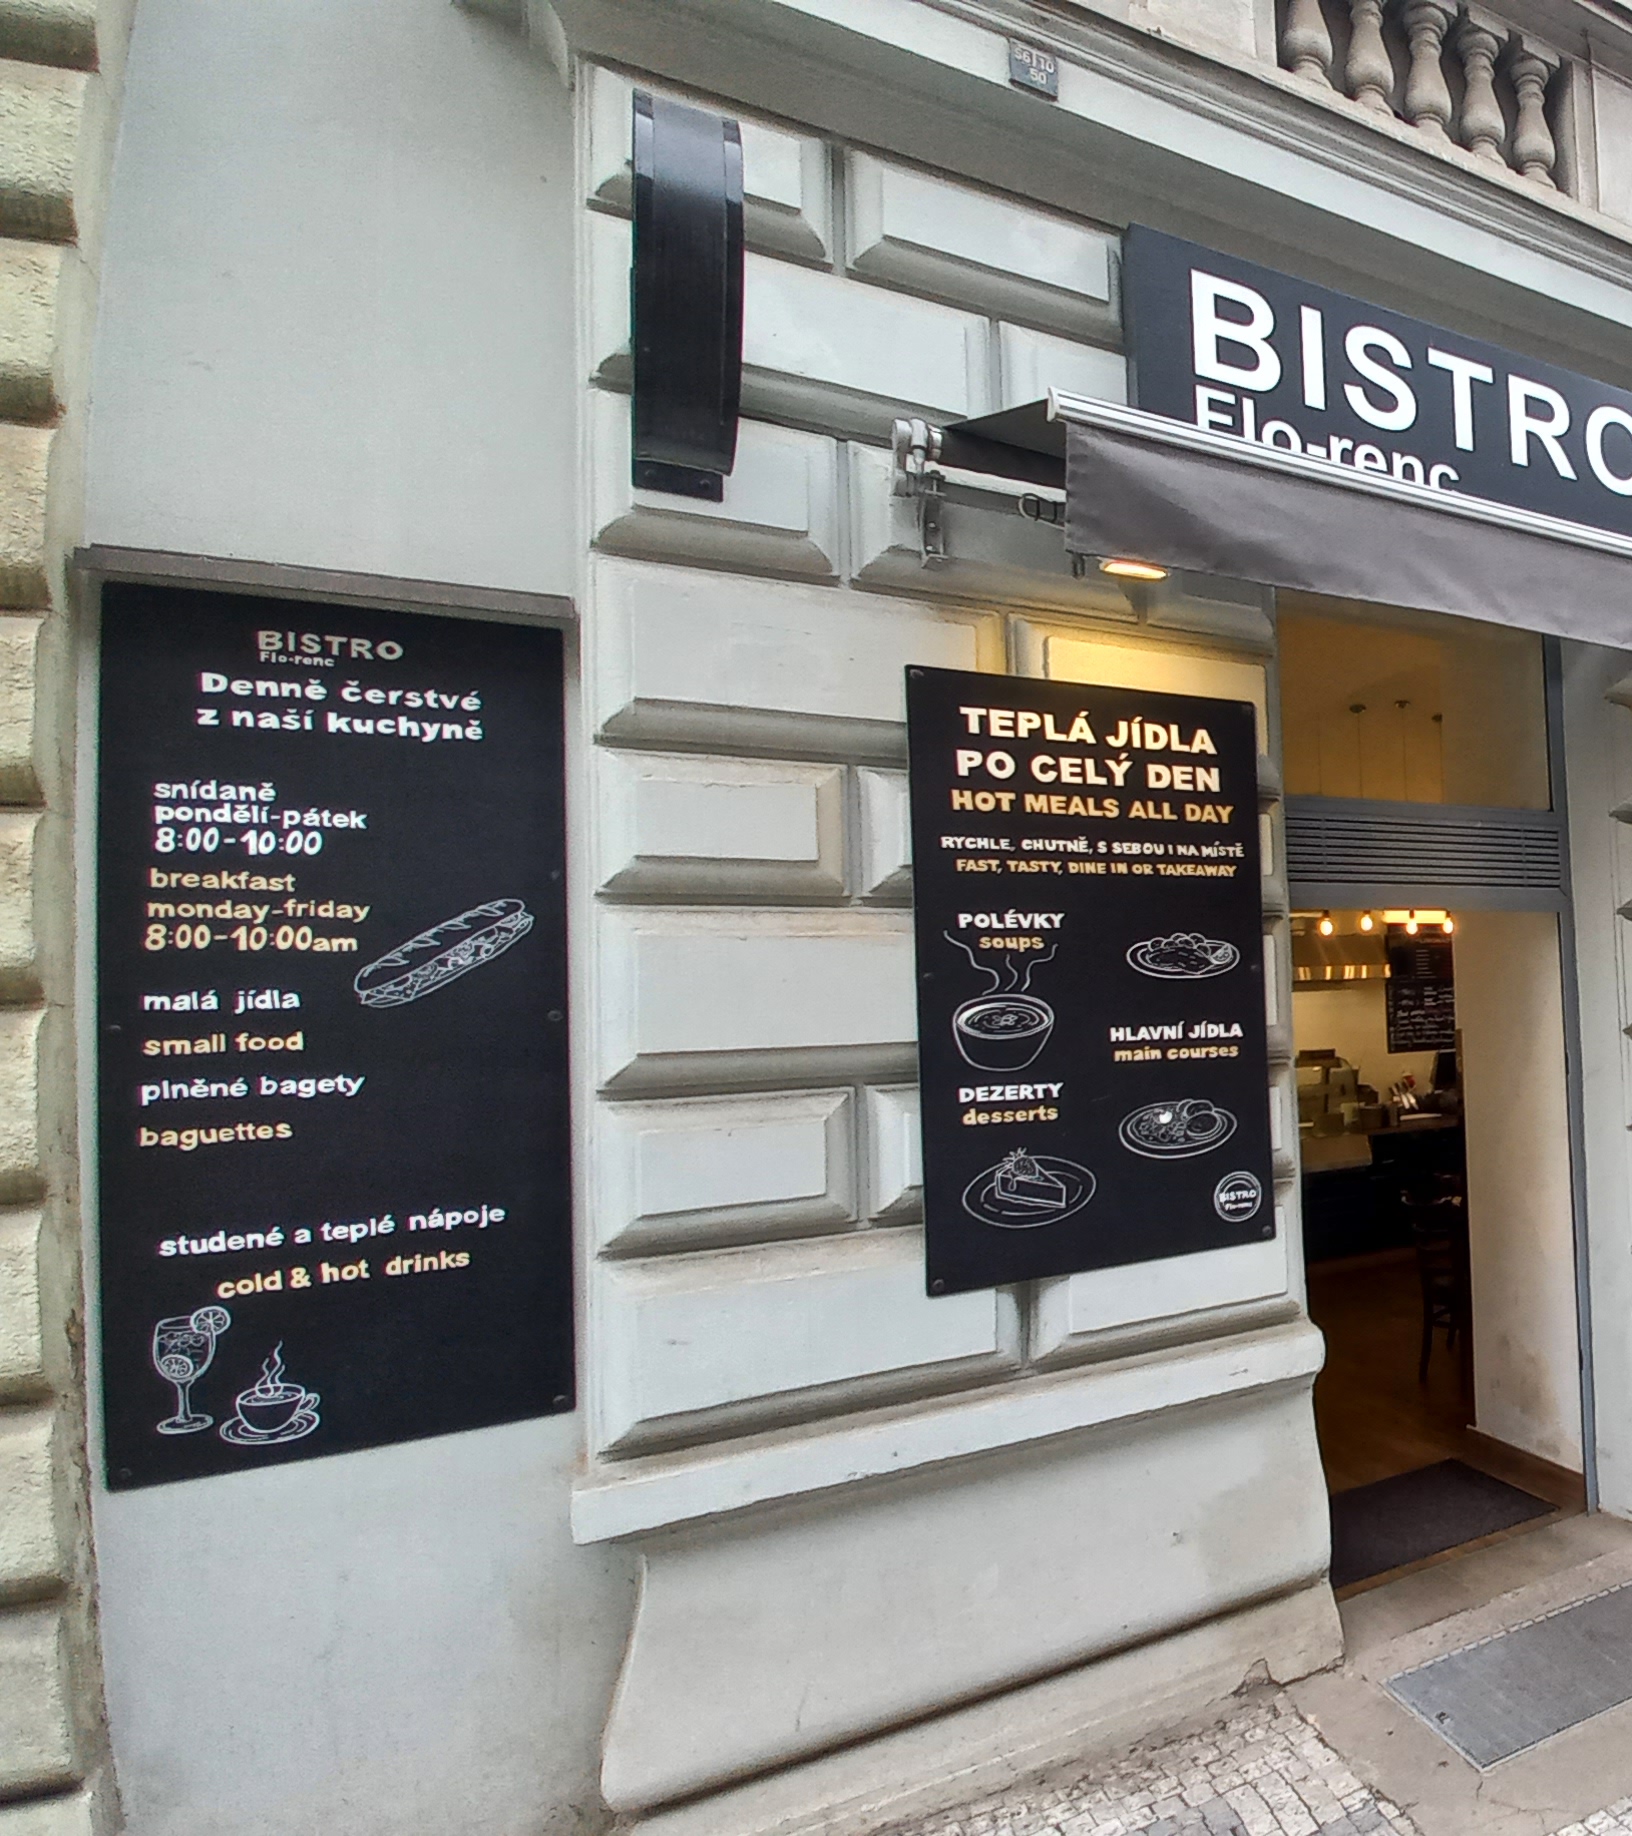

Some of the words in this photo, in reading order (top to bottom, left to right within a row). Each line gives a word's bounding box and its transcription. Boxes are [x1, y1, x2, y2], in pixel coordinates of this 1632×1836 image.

[257, 630, 403, 661] BISTRO
[260, 651, 335, 668] Flo-renc
[200, 672, 327, 700] Denně
[341, 680, 482, 711] čerstvé
[197, 709, 220, 726] z
[232, 708, 314, 731] naší
[327, 712, 484, 742] kuchyně
[959, 705, 1096, 745] TEPLÁ
[1105, 716, 1217, 755] JÍDLA
[955, 749, 1015, 779] PO
[1031, 752, 1133, 787] CELÝ
[1146, 763, 1221, 793] DEN
[154, 780, 276, 801] snídaně
[154, 803, 367, 831] pondělí-pátek
[951, 789, 1015, 813] HOT
[1024, 794, 1119, 818] MEALS
[1128, 801, 1178, 821] ALL
[1185, 803, 1235, 824] DAY
[154, 827, 323, 856] 8:00-10:00
[940, 836, 1016, 852] RYCHLE,
[1021, 837, 1094, 855] CHUTNĚ,
[1097, 840, 1108, 855] S
[1112, 841, 1165, 856] SEBOU
[1176, 844, 1199, 857] NA
[1201, 840, 1245, 859] MÍSTĚ
[149, 868, 296, 893] breakfast
[956, 859, 1003, 875] FAST,
[1006, 860, 1063, 875] TASTY,
[1068, 861, 1107, 875] DINE
[1110, 862, 1128, 875] IN
[1131, 863, 1153, 876] OR
[1156, 863, 1238, 878] TAKEAWAY
[147, 900, 371, 924] monday-friday
[958, 909, 1065, 929] POLÉVKY
[979, 935, 1045, 952] soups
[143, 990, 218, 1011] malá
[234, 989, 301, 1015] jídla
[1109, 1021, 1184, 1042] HLAVNÍ
[1188, 1020, 1243, 1039] JÍDLA
[143, 1034, 226, 1056] small
[235, 1032, 304, 1052] food
[1114, 1046, 1162, 1062] main
[1167, 1044, 1239, 1061] courses
[140, 1079, 248, 1106] plněné
[260, 1073, 365, 1098] bagety
[958, 1082, 1064, 1103] DEZERTY
[962, 1105, 1058, 1126] desserts
[139, 1120, 293, 1151] baguettes
[1219, 1189, 1256, 1202] BISTRO
[158, 1227, 284, 1257] studené
[295, 1227, 311, 1243] a
[321, 1215, 395, 1244] teplé
[409, 1204, 506, 1231] nápoje
[217, 1270, 283, 1299] cold
[290, 1267, 311, 1288] &
[321, 1260, 370, 1285] hot
[385, 1250, 471, 1278] drinks
